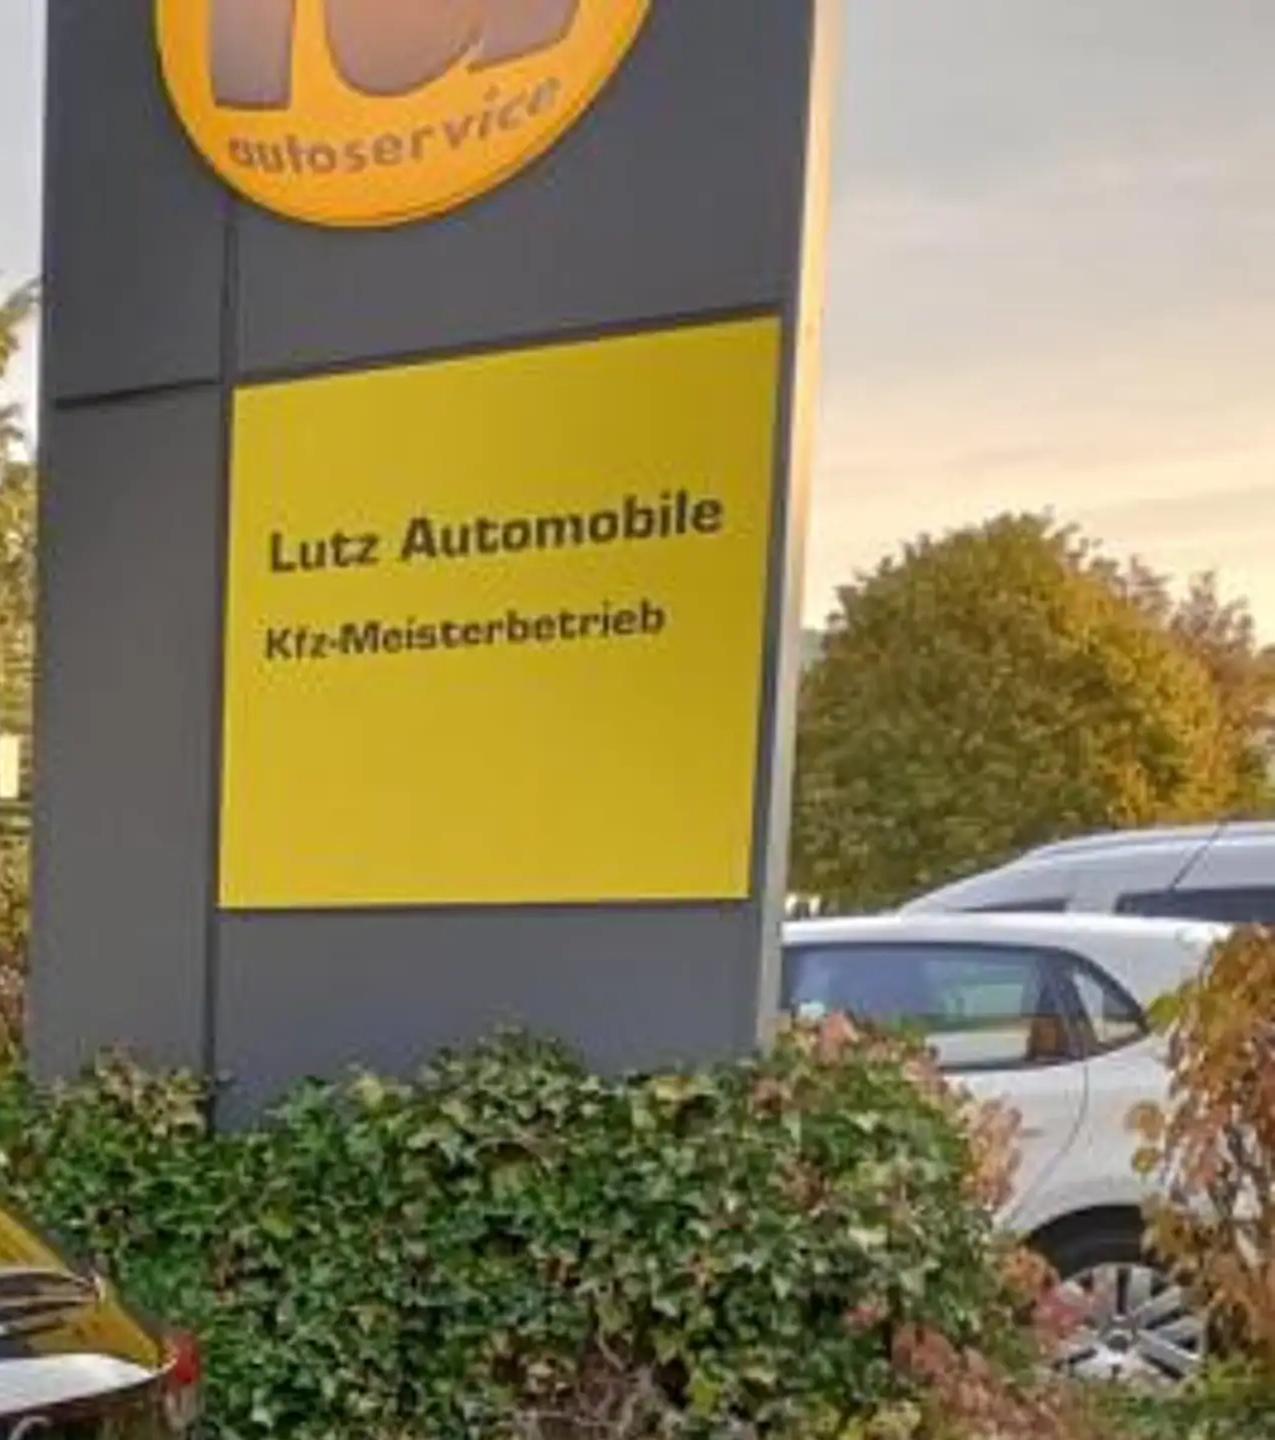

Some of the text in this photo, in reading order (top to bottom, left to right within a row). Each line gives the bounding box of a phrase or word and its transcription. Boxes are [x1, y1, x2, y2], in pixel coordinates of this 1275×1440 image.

[227, 75, 565, 174] autoservice
[268, 488, 724, 574] Lutz Automobile
[263, 598, 667, 661] Kfz-Meisterbetrieb
